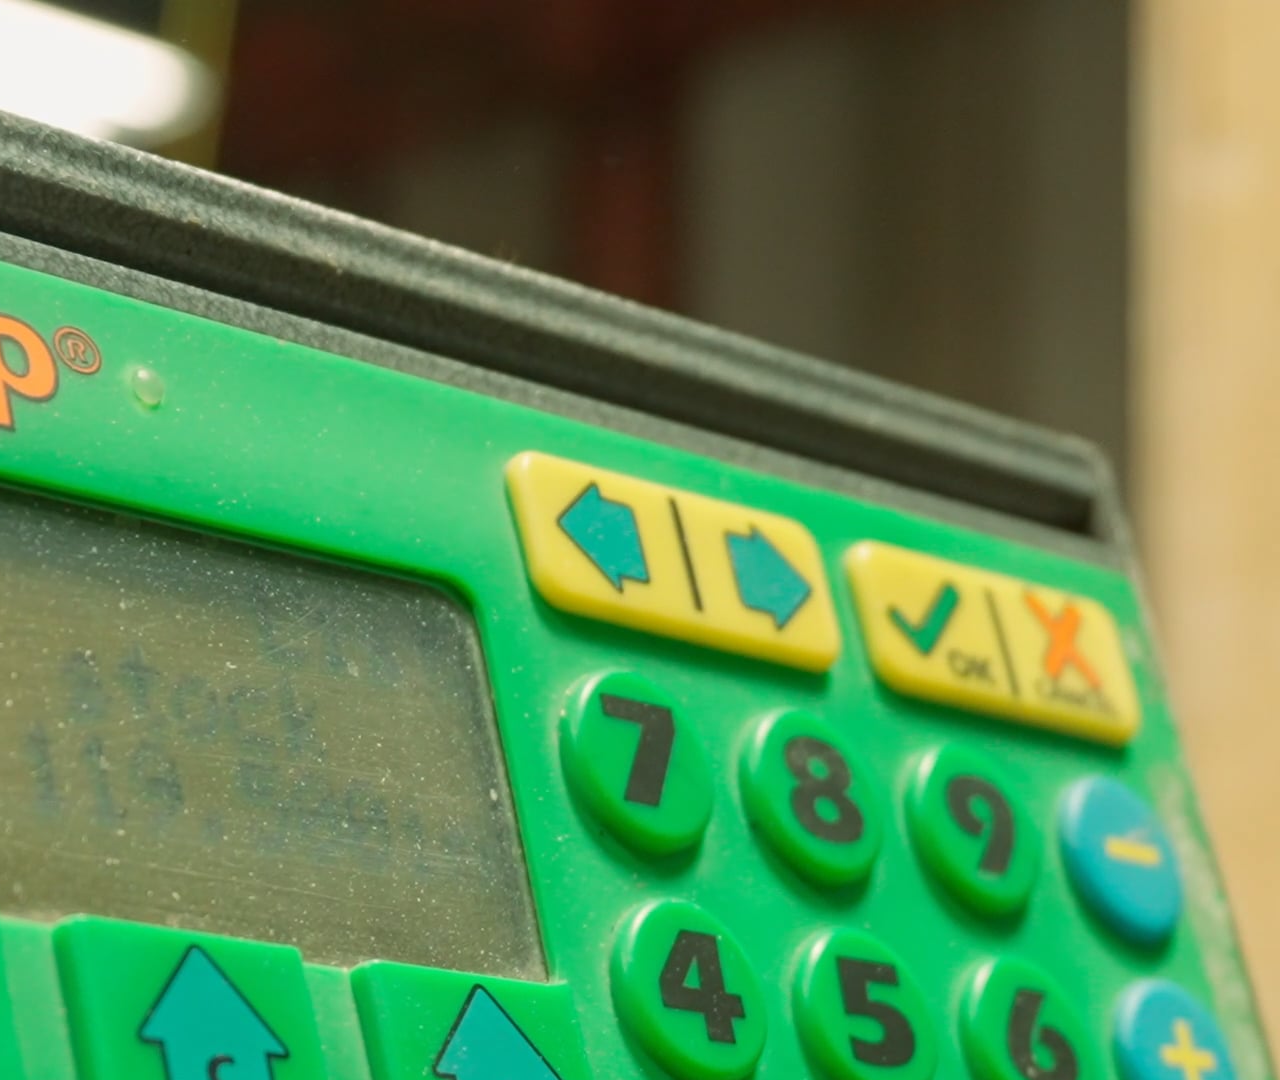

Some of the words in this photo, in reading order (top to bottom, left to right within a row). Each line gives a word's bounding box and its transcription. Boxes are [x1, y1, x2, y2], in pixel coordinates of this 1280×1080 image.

[946, 648, 998, 686] OK
[599, 692, 677, 808] 7
[783, 735, 865, 845] 8
[946, 776, 1017, 876] 9
[658, 929, 747, 1046] 4
[836, 955, 917, 1068] 5
